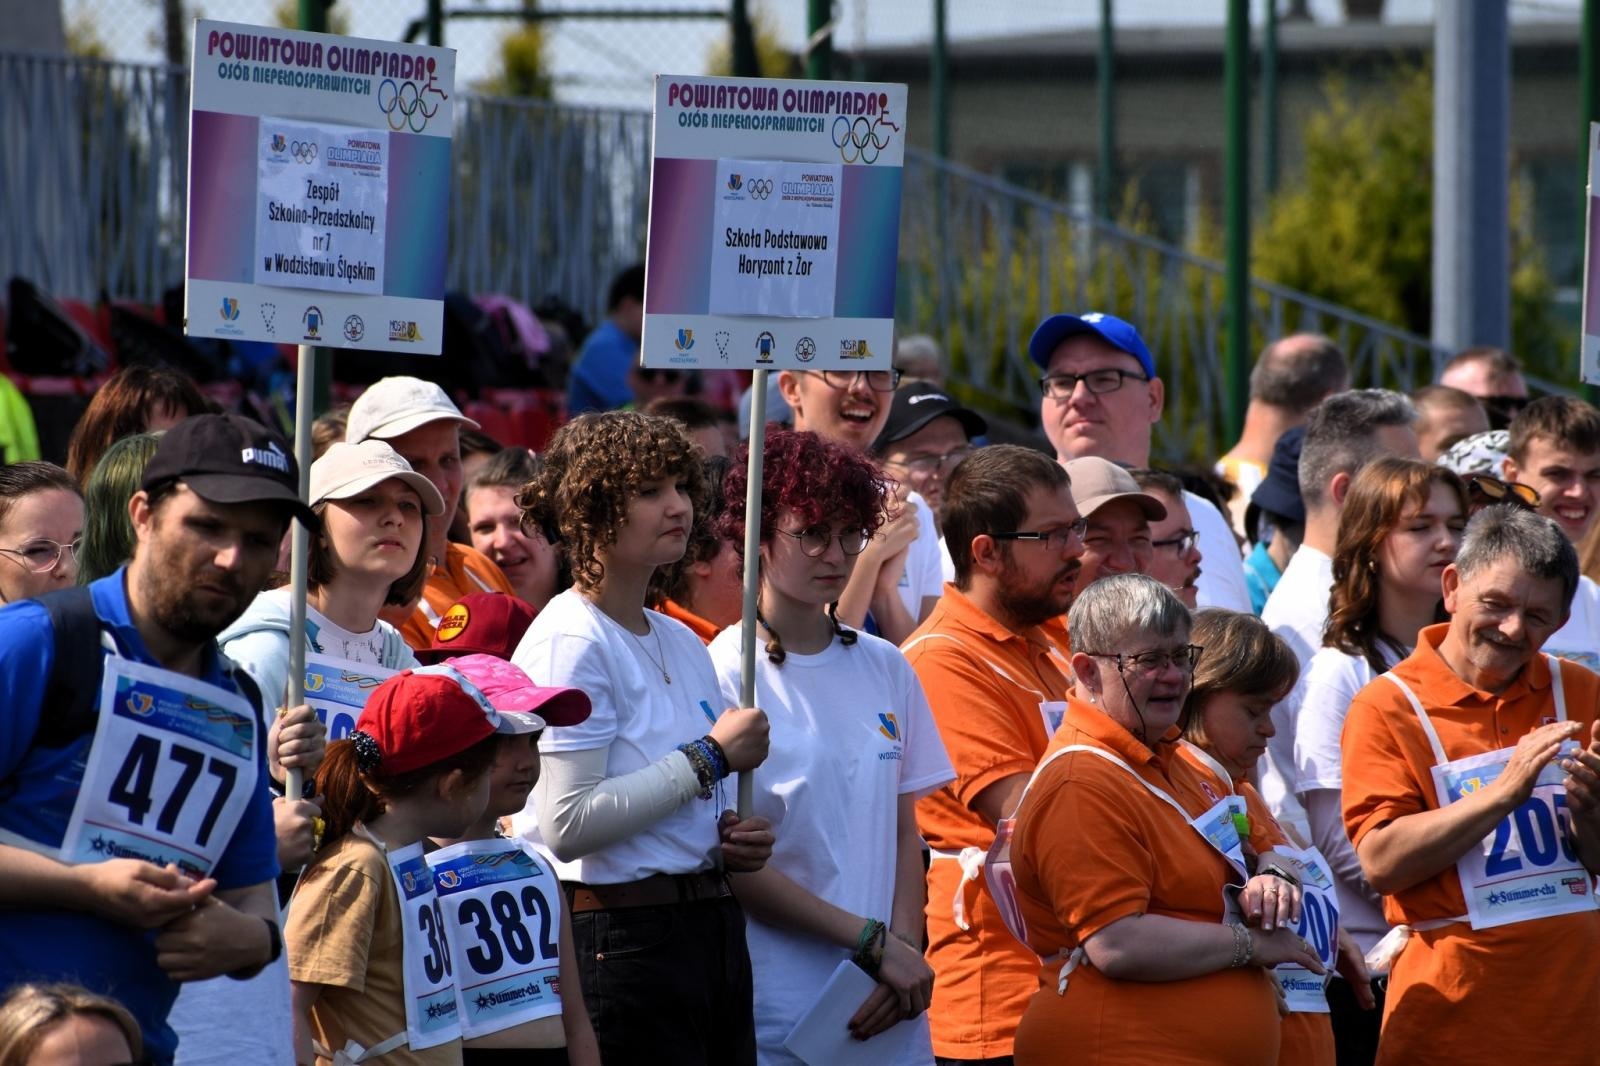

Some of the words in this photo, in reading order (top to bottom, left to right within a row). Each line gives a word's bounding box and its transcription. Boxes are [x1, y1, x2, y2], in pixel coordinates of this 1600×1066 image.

[208, 30, 321, 68] POWIATOWA
[327, 46, 424, 81] OLIMPIADA
[218, 62, 249, 81] OSÓB
[669, 83, 778, 111] POWIATOWA
[782, 88, 876, 116] OLIMPIADA
[678, 110, 707, 128] OSÓB
[327, 147, 382, 164] OLIMPIADA
[347, 139, 381, 150] POWIATOWA
[781, 182, 834, 196] OLIMPIADA
[801, 174, 834, 183] POWIATOWA
[307, 179, 339, 205] Zespół
[269, 201, 375, 234] Szkolno-Przedszkolny
[312, 236, 323, 251] nr
[326, 233, 332, 251] 7
[725, 227, 761, 248] Szkoła
[764, 229, 828, 250] Podstawowa
[264, 256, 273, 272] w
[274, 253, 335, 277] Wodzisławiu
[337, 255, 376, 284] Śląskim
[738, 254, 785, 279] Horyzont
[788, 260, 793, 275] z
[796, 252, 813, 276] Żor
[107, 733, 238, 848] 477
[1500, 882, 1557, 903] Summer-cha
[458, 886, 558, 975] 382
[488, 982, 541, 1006] Summer-cha
